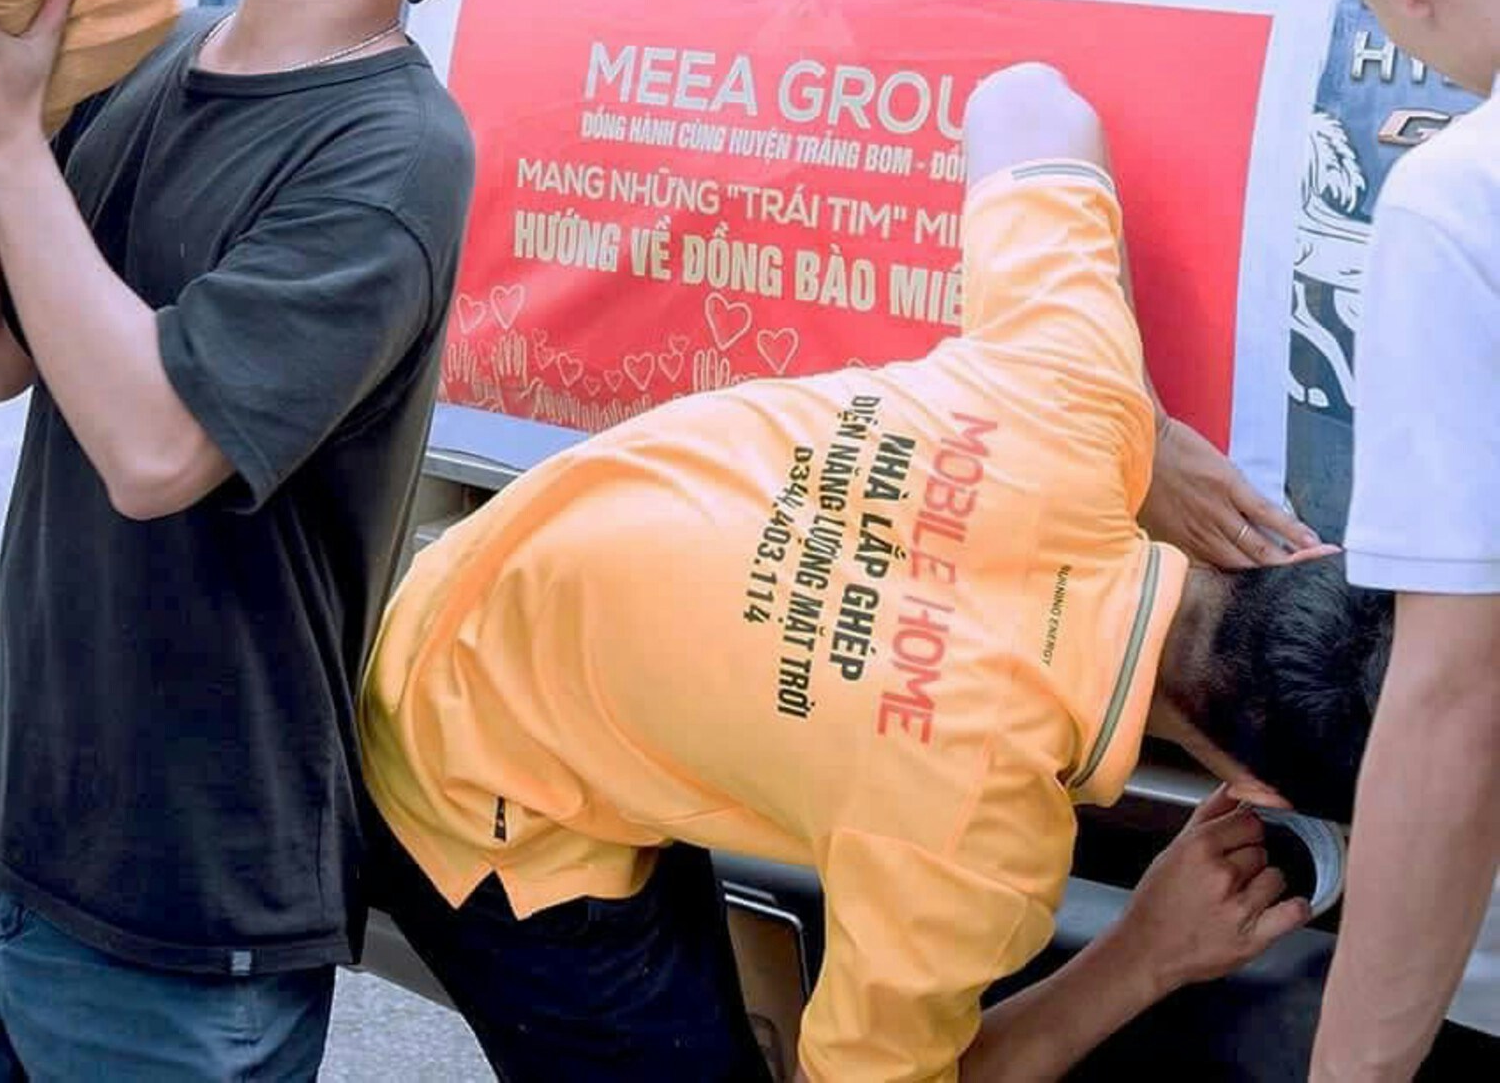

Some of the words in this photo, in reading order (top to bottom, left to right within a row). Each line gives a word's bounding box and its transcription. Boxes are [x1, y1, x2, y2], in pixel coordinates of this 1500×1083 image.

[584, 41, 758, 117] MEEA
[778, 59, 967, 142] GROU
[580, 104, 627, 142] ĐỒNG
[629, 111, 676, 147] HÀNH
[678, 118, 727, 153] CÙNG
[728, 126, 793, 165] HUYỆN
[864, 143, 914, 177] BOM
[517, 158, 605, 200] MANG
[610, 166, 721, 215] NHỮNG
[727, 183, 820, 230] "TRÁI
[827, 196, 908, 240] TIM"
[914, 208, 964, 250] MI
[514, 207, 621, 273] HƯỚNG
[631, 214, 672, 282] VỀ
[681, 220, 784, 299] ĐỒNG
[794, 242, 876, 312] BÀO
[818, 443, 862, 512] NĂNG
[863, 432, 917, 502] NHÀ
[909, 411, 999, 584] MOBILE
[794, 514, 846, 592] LƯỢNG
[853, 511, 908, 579] LẮP
[777, 590, 827, 653] MẶT
[829, 582, 881, 682] GHÉP
[777, 656, 816, 720] TRỜI
[877, 594, 956, 745] HOME
